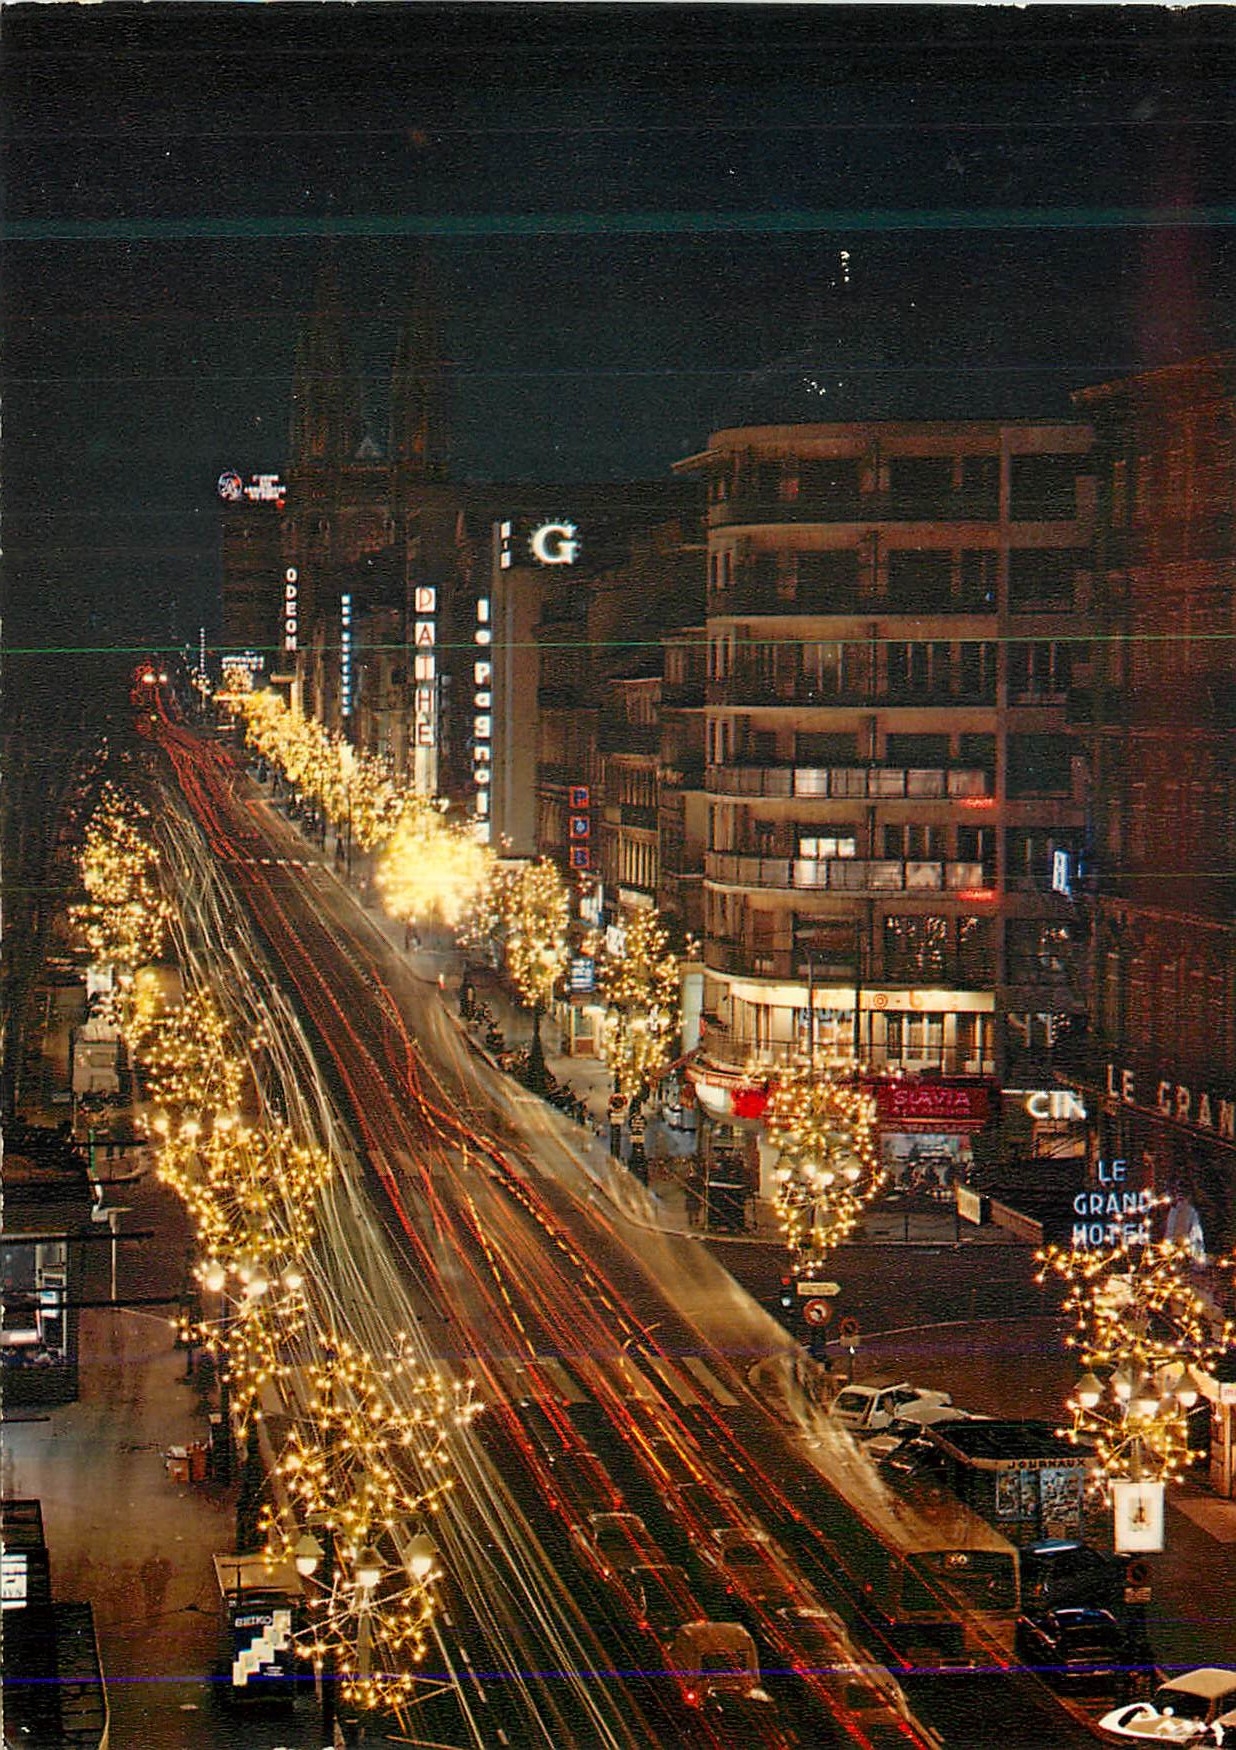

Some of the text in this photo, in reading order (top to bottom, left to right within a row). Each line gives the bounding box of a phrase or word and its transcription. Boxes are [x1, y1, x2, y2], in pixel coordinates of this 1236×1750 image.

[285, 567, 298, 651] ODEON
[1106, 1064, 1135, 1105] LE
[1098, 1159, 1128, 1182] LE
[1072, 1191, 1152, 1216] GRAND
[1071, 1223, 1151, 1246] HOTEL
[1007, 1459, 1087, 1470] JOURNAUX
[235, 1615, 273, 1627] SEIKO
